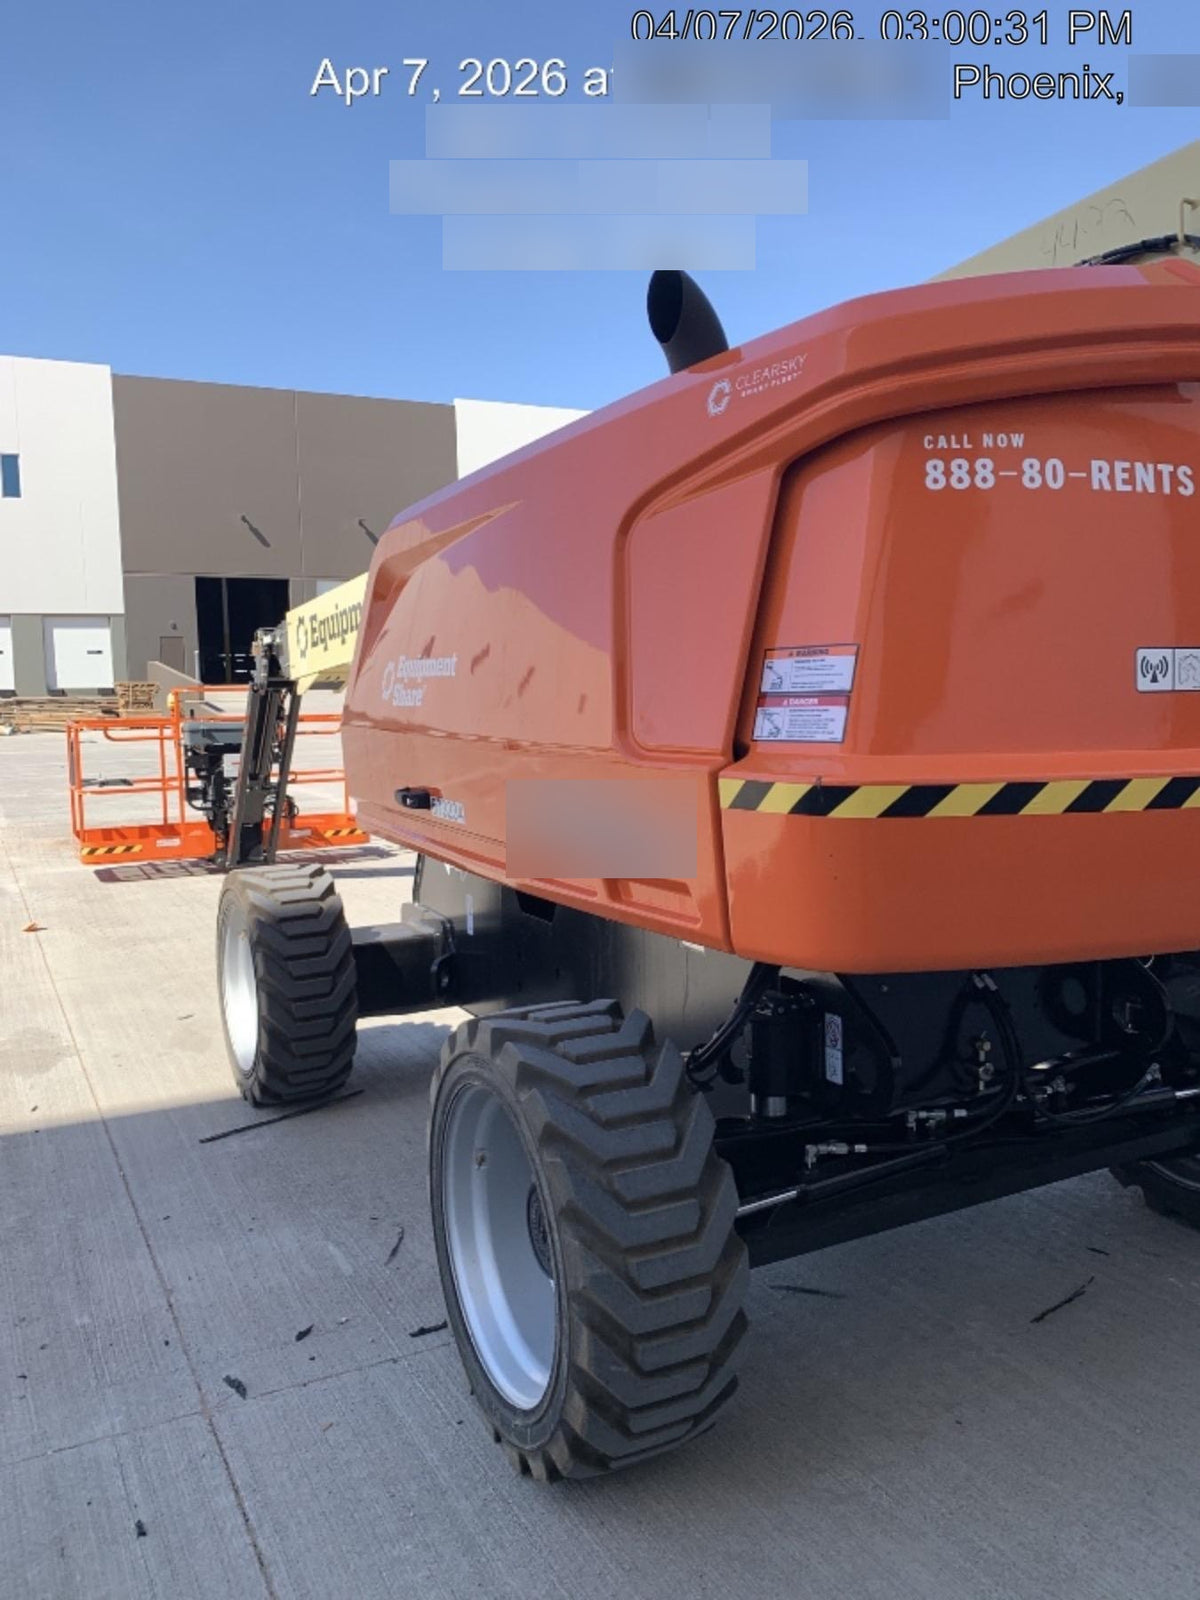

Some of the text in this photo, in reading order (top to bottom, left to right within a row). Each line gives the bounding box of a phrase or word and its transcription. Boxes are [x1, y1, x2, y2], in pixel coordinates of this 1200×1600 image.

[735, 353, 808, 391] CLEARSKY
[923, 433, 1025, 450] CALL NOW
[925, 457, 1195, 496] 888-80-RENTS
[397, 653, 458, 683] Equipment
[393, 683, 423, 707] Share
